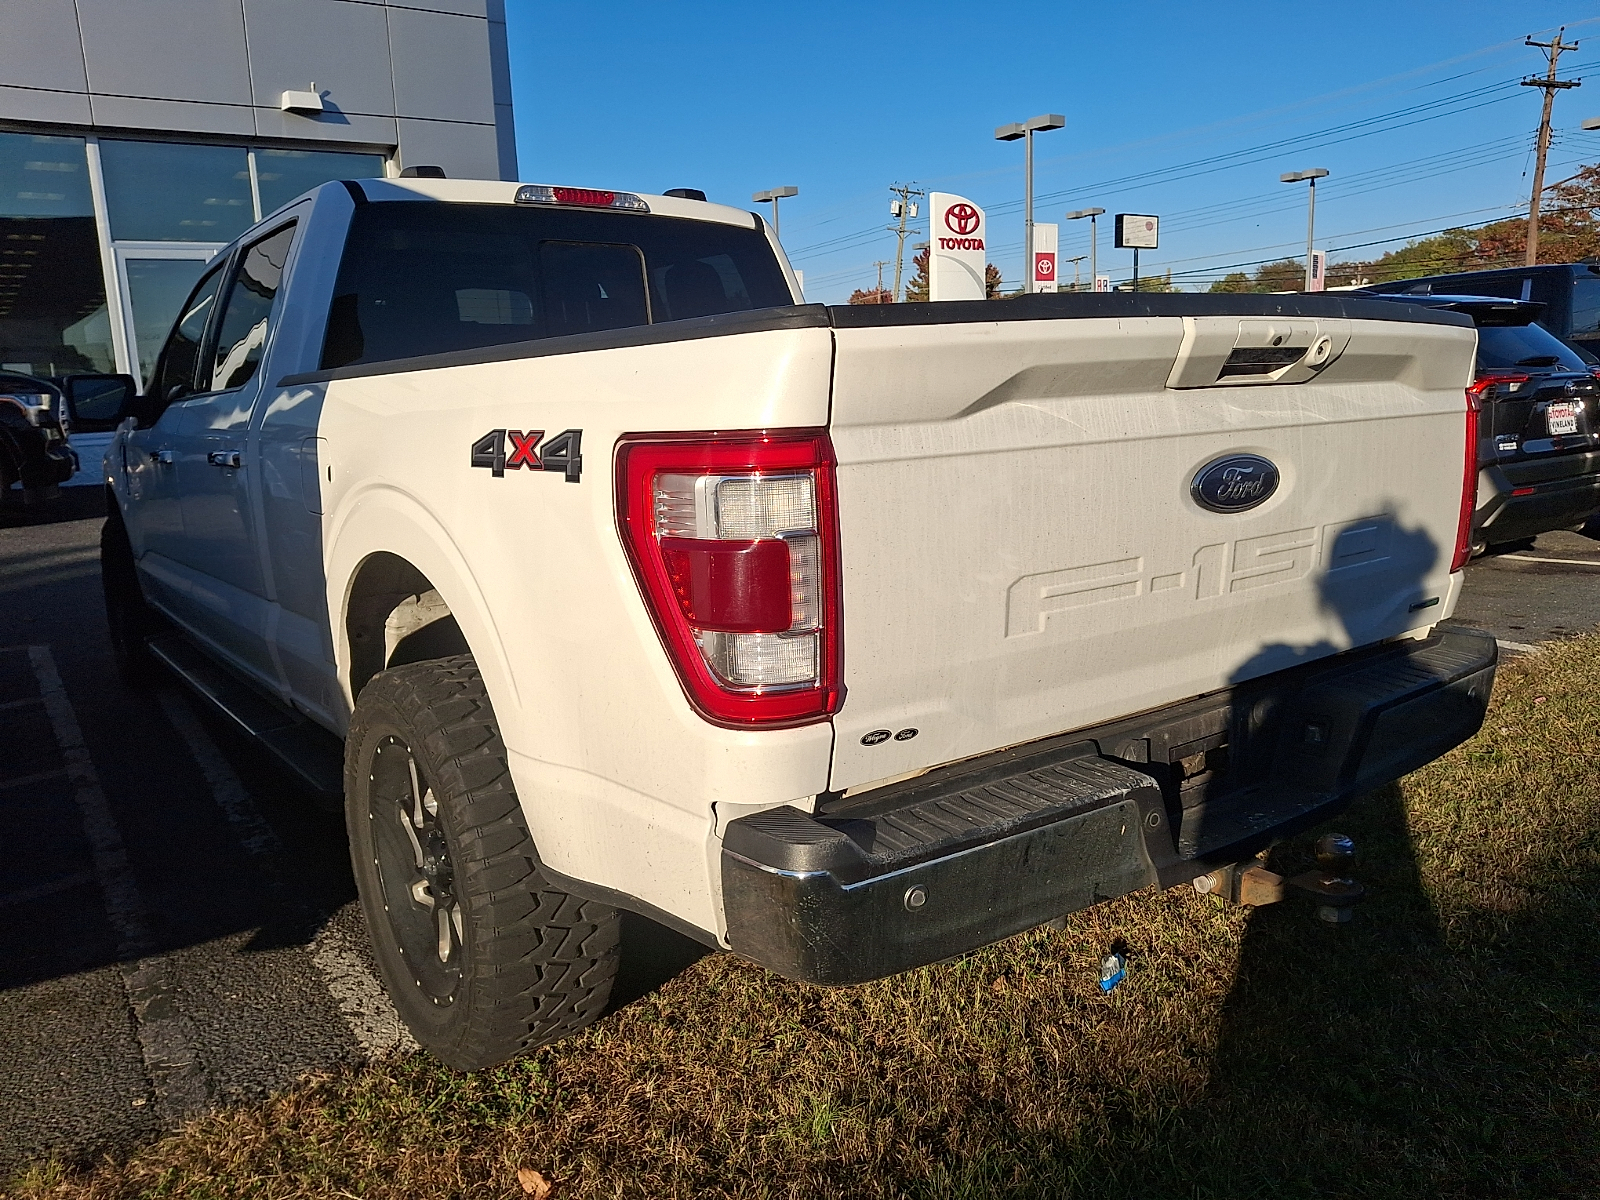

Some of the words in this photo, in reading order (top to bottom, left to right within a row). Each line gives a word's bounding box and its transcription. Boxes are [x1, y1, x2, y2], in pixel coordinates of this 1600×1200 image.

[938, 237, 985, 250] TOYOTA
[1552, 408, 1571, 419] TOYOTA
[1550, 419, 1574, 429] VINELAND
[1217, 466, 1265, 501] Ford
[1005, 513, 1396, 639] F-150
